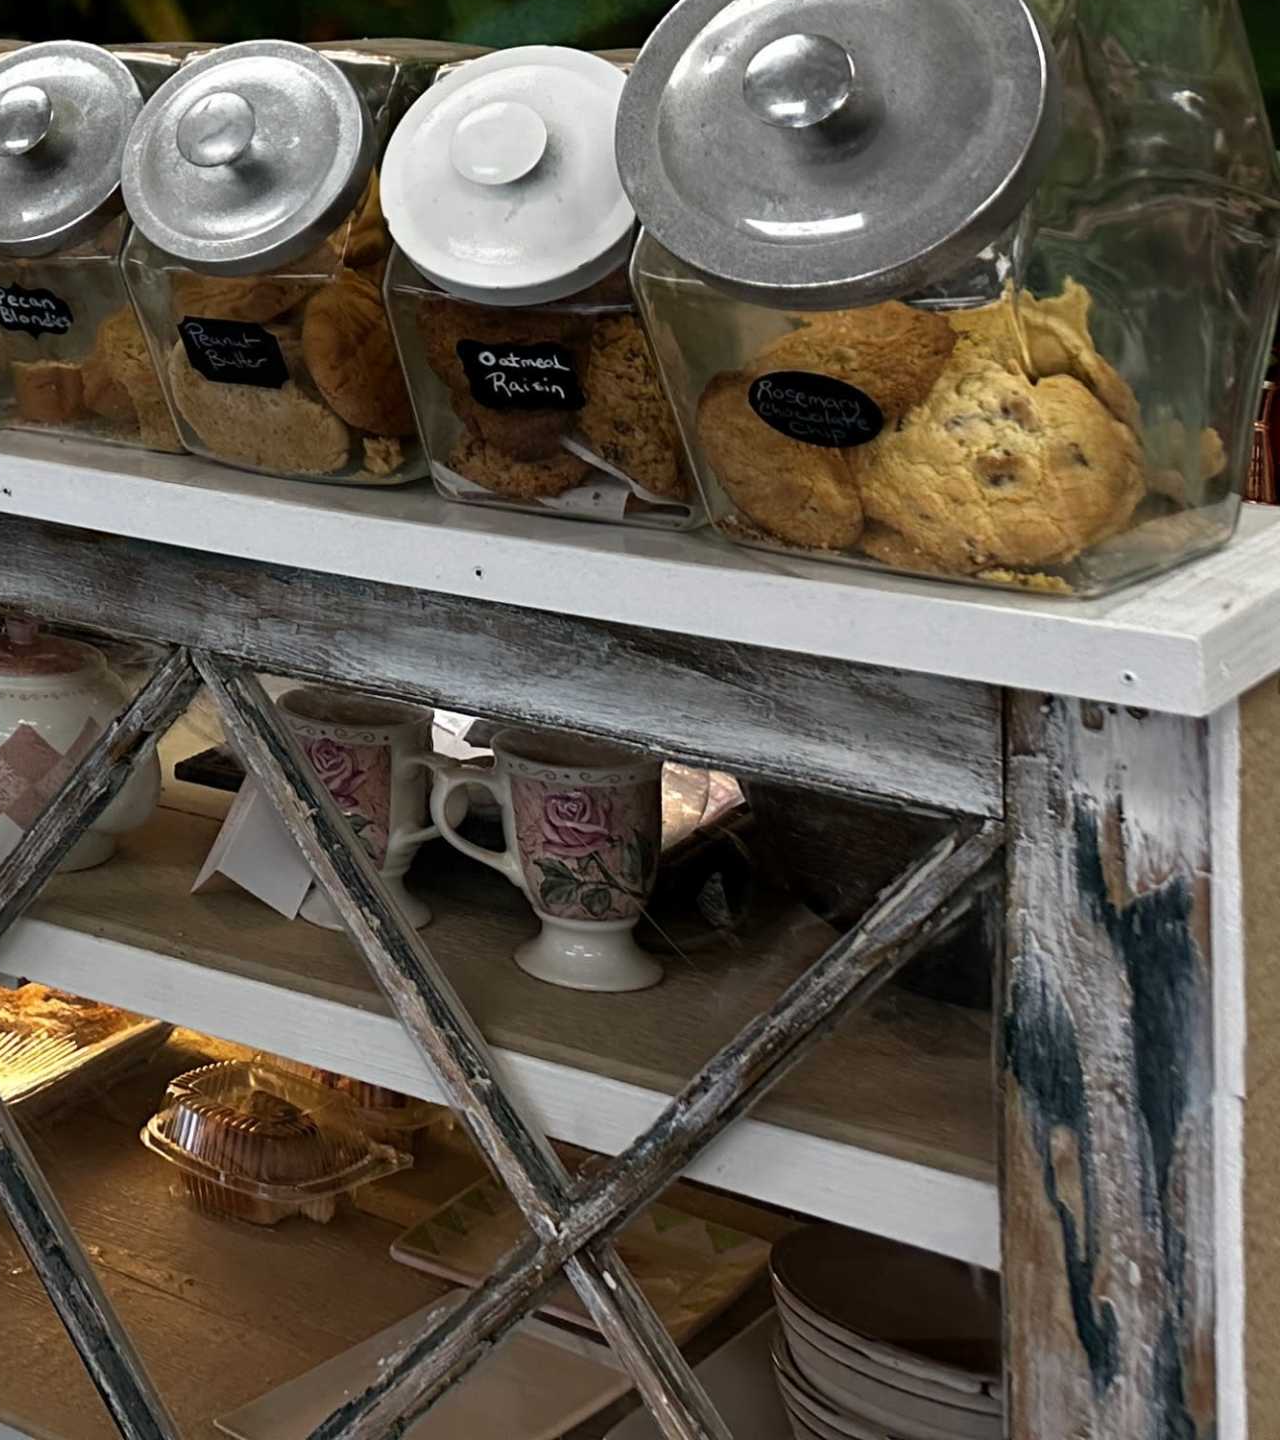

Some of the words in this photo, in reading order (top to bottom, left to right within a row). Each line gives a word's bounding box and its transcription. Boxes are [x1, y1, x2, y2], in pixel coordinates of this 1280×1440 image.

[184, 322, 261, 350] Peanut
[204, 348, 268, 370] Butter
[478, 351, 571, 372] Oatmeal
[484, 371, 566, 399] Raisin
[757, 380, 861, 420] Rosemary
